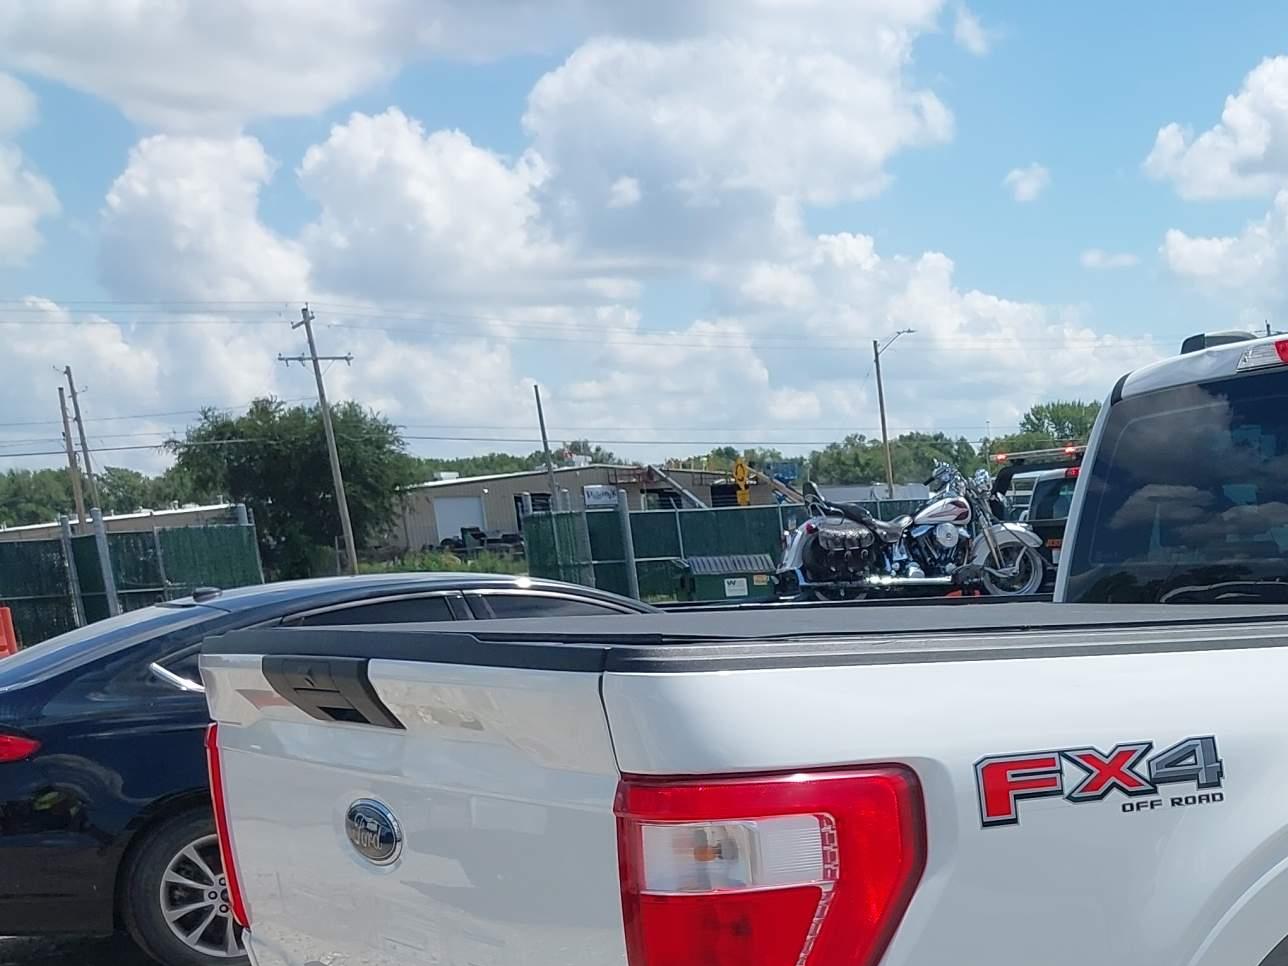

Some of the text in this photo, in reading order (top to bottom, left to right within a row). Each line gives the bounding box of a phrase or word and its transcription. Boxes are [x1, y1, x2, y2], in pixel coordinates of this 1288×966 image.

[974, 735, 1224, 828] FX4
[1122, 792, 1224, 813] OFF ROAD
[352, 812, 382, 849] Ford
